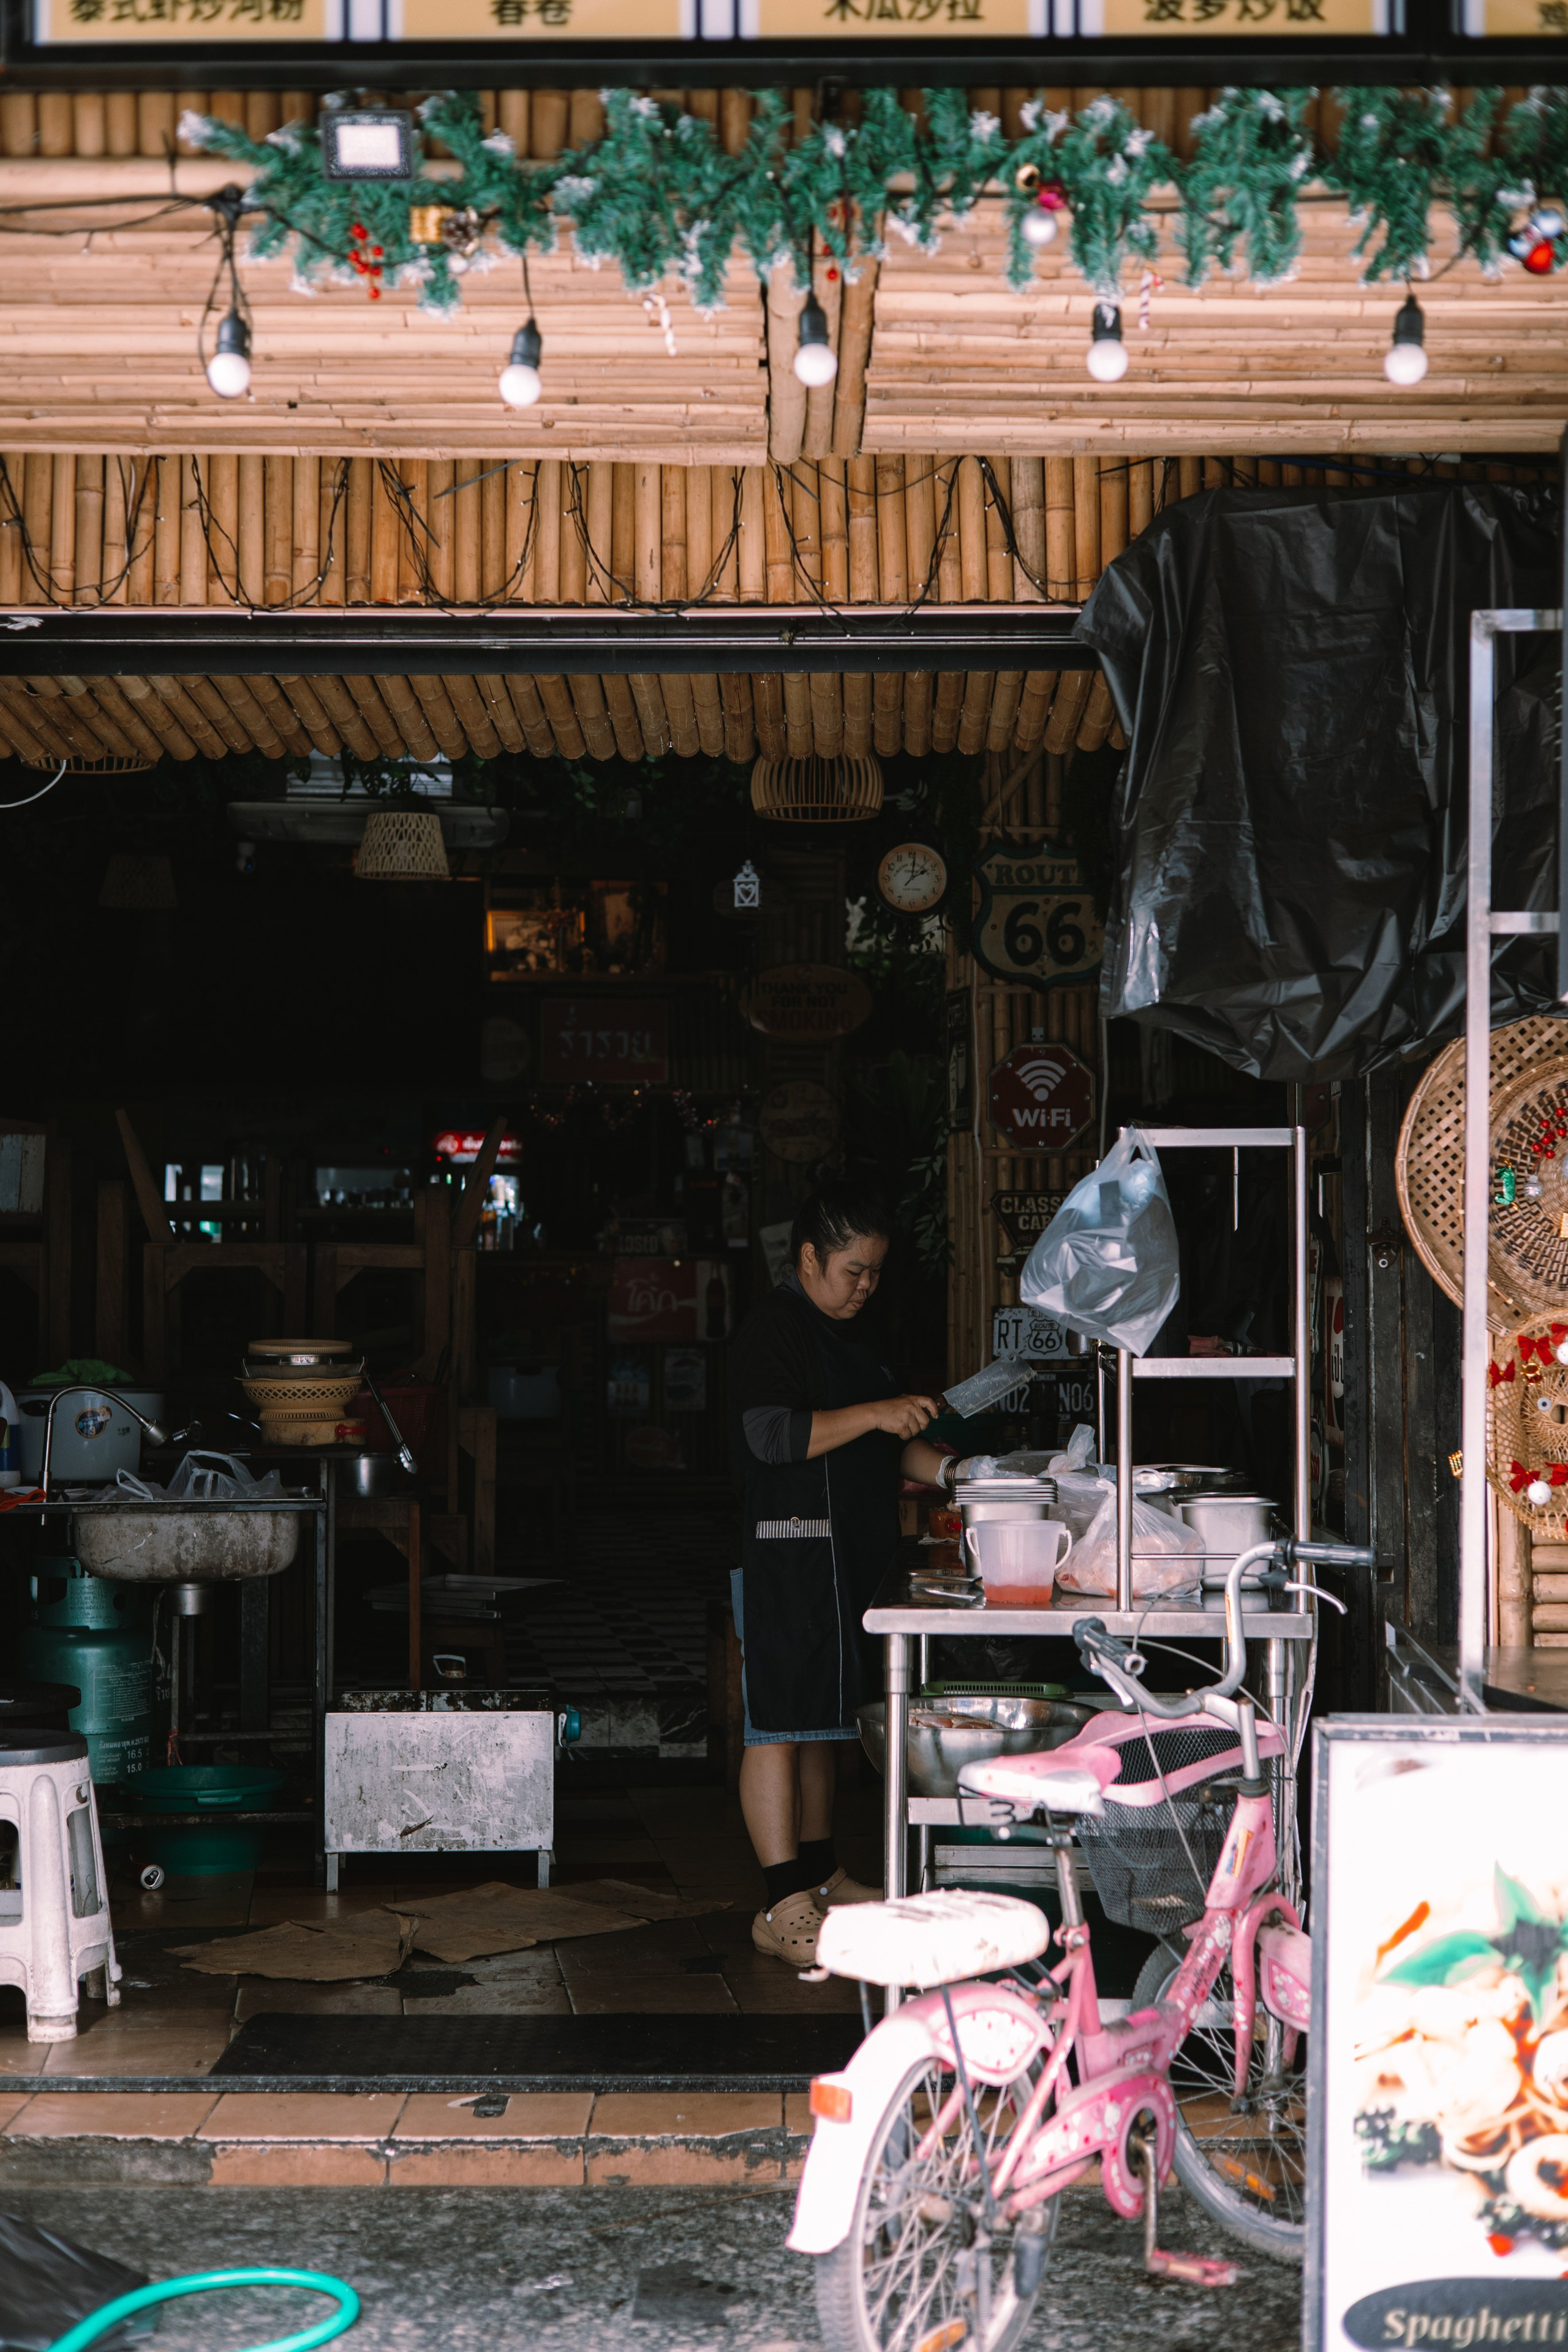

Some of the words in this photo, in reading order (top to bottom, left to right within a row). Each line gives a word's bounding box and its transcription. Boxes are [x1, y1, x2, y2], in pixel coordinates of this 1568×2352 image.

[1004, 901, 1086, 967] 66
[759, 982, 811, 994] THANK
[814, 982, 848, 993] YOU
[771, 995, 802, 1008] FOR
[807, 995, 836, 1008] NOT
[755, 1010, 853, 1030] SMOKING
[1001, 1196, 1067, 1214] CLASS
[619, 1235, 658, 1253] LOSED
[998, 1319, 1022, 1348] RT
[1033, 1332, 1056, 1348] 66
[127, 1749, 142, 1760] 16.5
[127, 1762, 142, 1773] 15.0
[1382, 2306, 1568, 2350] Spaghetti
